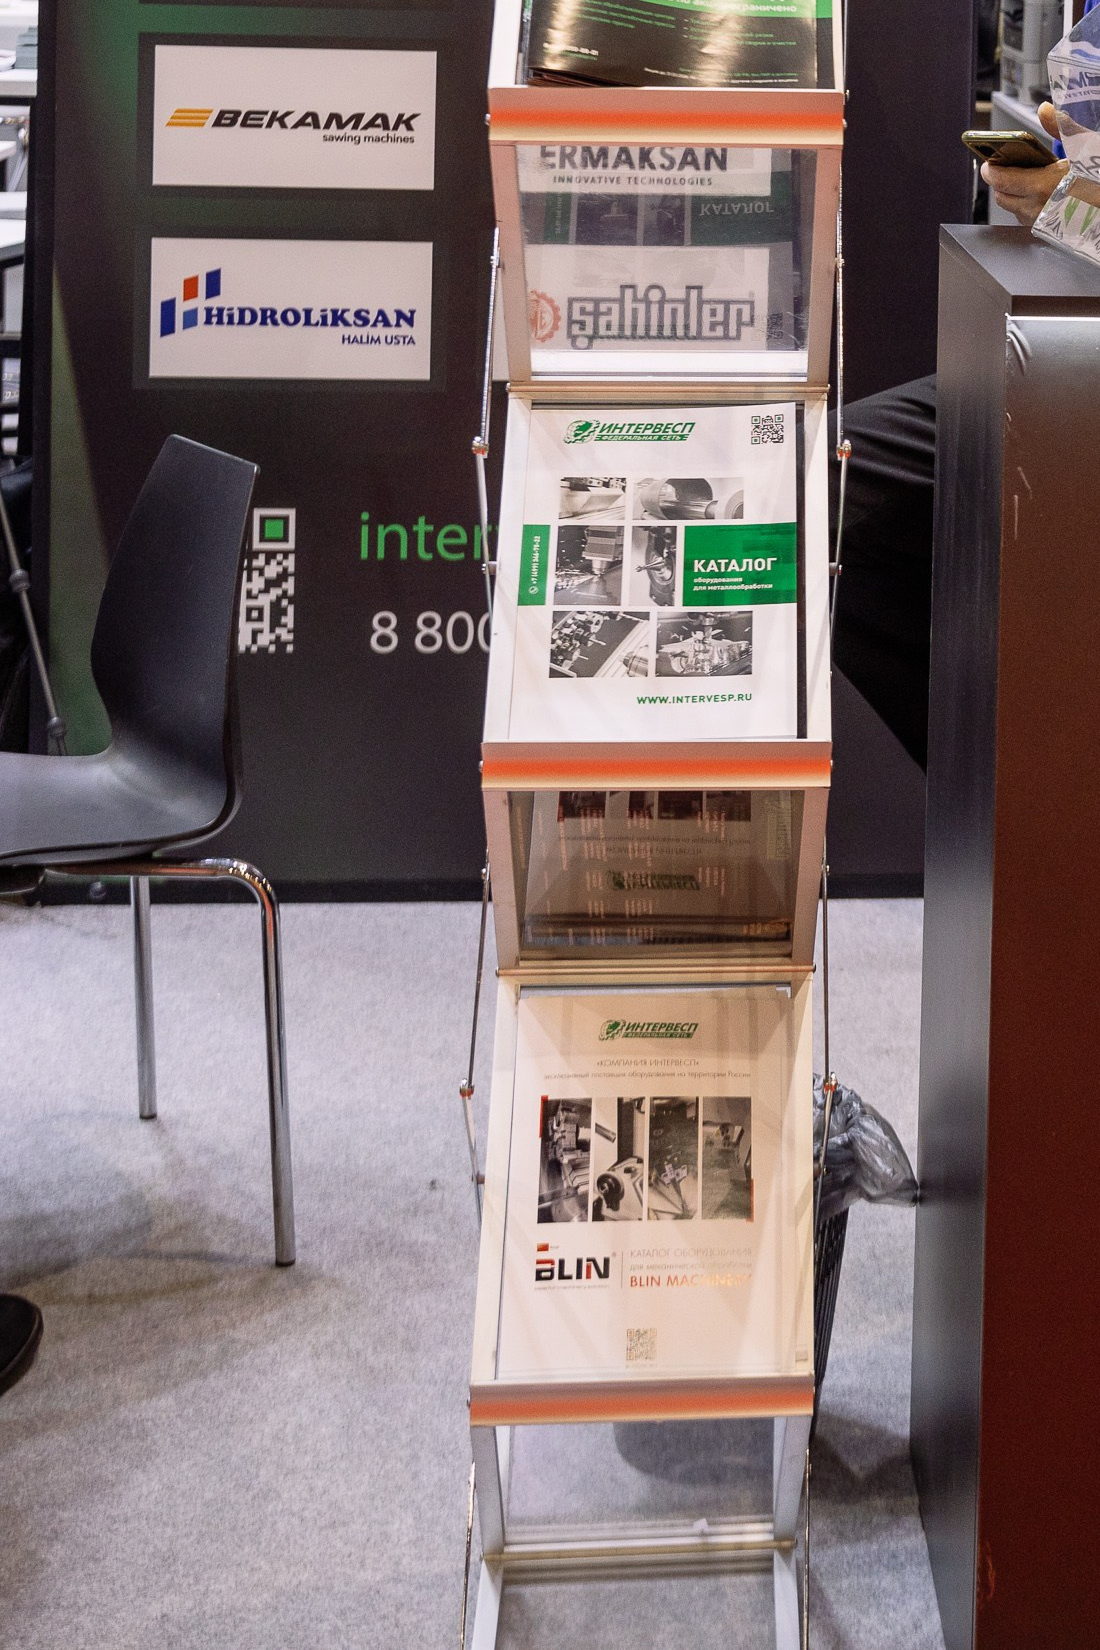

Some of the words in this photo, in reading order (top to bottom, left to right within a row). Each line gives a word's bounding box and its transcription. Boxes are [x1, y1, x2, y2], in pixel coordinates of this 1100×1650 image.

[211, 109, 421, 132] BEKAMAK
[322, 135, 361, 145] sawing
[363, 133, 415, 143] machines
[540, 144, 728, 172] ERMAKSAN
[553, 175, 621, 185] INNOVATIVE
[627, 176, 713, 186] TECHNOLOGIES
[384, 334, 416, 346] USTA
[599, 422, 696, 434] ИНТЕРВЕСП
[360, 511, 499, 561] inter
[693, 557, 777, 573] КАТАЛОГ
[708, 583, 773, 591] металлообработки
[369, 610, 399, 654] 8
[637, 693, 752, 705] WWW.INTERVESP.RU
[625, 1022, 699, 1032] ИНТЕРВЕСП
[630, 1250, 670, 1258] КАТАЛОГ
[535, 1256, 610, 1281] BLIN
[630, 1276, 661, 1288] BLIN
